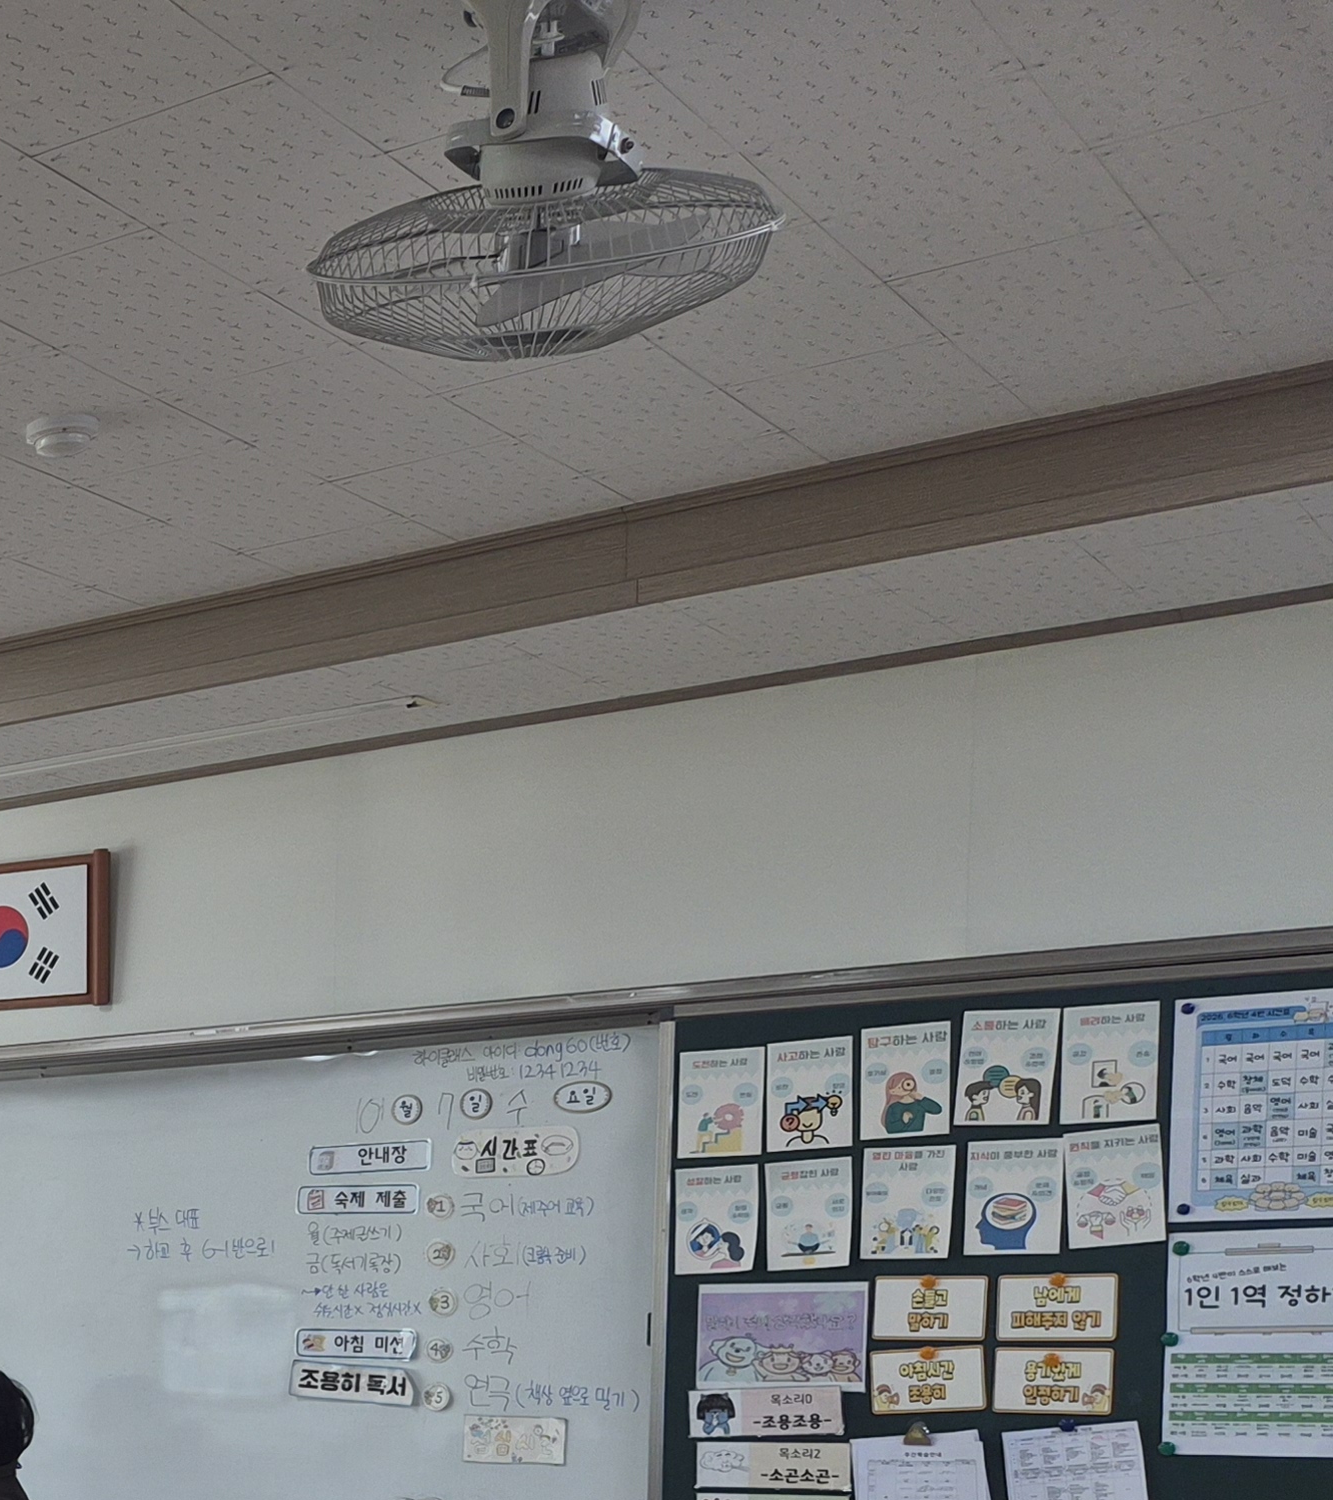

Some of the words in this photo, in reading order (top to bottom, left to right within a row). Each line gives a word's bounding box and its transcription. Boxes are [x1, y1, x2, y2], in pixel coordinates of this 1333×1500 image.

[972, 1019, 1018, 1030] 소통하는
[1023, 1018, 1047, 1030] 사람
[867, 1034, 917, 1048] 탐구하는
[922, 1030, 947, 1043] 사람
[777, 1050, 820, 1062] 사고하는
[823, 1047, 845, 1058] 사람
[1218, 1054, 1237, 1065] 국어
[1245, 1052, 1264, 1063] 국어
[1273, 1051, 1292, 1062] 국어
[1301, 1049, 1320, 1060] 국어
[1217, 1080, 1237, 1090] 수학
[1300, 1075, 1319, 1085] 수학
[399, 1100, 413, 1118] 월
[438, 1092, 454, 1130] 7
[469, 1094, 482, 1112] 일
[506, 1089, 528, 1126] 수
[566, 1087, 596, 1105] 요일
[1215, 1105, 1236, 1114] 사회
[1243, 1103, 1262, 1114] 음악
[1298, 1102, 1319, 1110] 사회
[1215, 1128, 1235, 1138] 영어
[1241, 1124, 1263, 1135] 과학
[1270, 1126, 1290, 1137] 음악
[1298, 1127, 1318, 1139] 미술
[480, 1135, 539, 1161] 시간표
[1103, 1137, 1136, 1149] 지키는
[1138, 1134, 1159, 1145] 사람
[357, 1145, 408, 1166] 안내장
[970, 1150, 1000, 1161] 지식이
[1003, 1149, 1033, 1160] 풍부한
[1037, 1149, 1058, 1159] 사람
[1214, 1154, 1235, 1164] 과학
[1241, 1154, 1262, 1163] 사회
[1268, 1151, 1290, 1163] 수학
[1297, 1151, 1317, 1162] 미술
[1241, 1174, 1262, 1185] 실과
[334, 1190, 365, 1209] 숙제
[375, 1189, 408, 1209] 제출
[175, 1208, 200, 1229] 대표
[180, 1237, 191, 1263] 후
[1187, 1273, 1210, 1284] 6학년
[1239, 1266, 1260, 1276] 스스로
[353, 1281, 389, 1298] 사람은
[911, 1289, 949, 1309] 손들고
[1034, 1286, 1082, 1307] 남에게
[1184, 1285, 1220, 1309] 1인
[1230, 1284, 1266, 1308] 1역
[1278, 1284, 1333, 1307] 정하
[463, 1281, 532, 1320] 영어
[908, 1312, 949, 1332] 말하기
[1072, 1310, 1102, 1331] 않기
[334, 1335, 364, 1353] 아침
[375, 1335, 404, 1354] 미션
[462, 1326, 518, 1365] 수학
[898, 1359, 955, 1382] 아침시간
[298, 1369, 361, 1393] 조용히
[367, 1374, 407, 1397] 독서
[770, 1393, 813, 1405] 목소리0
[908, 1384, 947, 1404] 조용히
[1023, 1385, 1080, 1405] 인정하기
[753, 1413, 832, 1430] -조용조용-
[778, 1447, 821, 1460] 목소리2
[760, 1468, 840, 1484] -소곤소곤-
